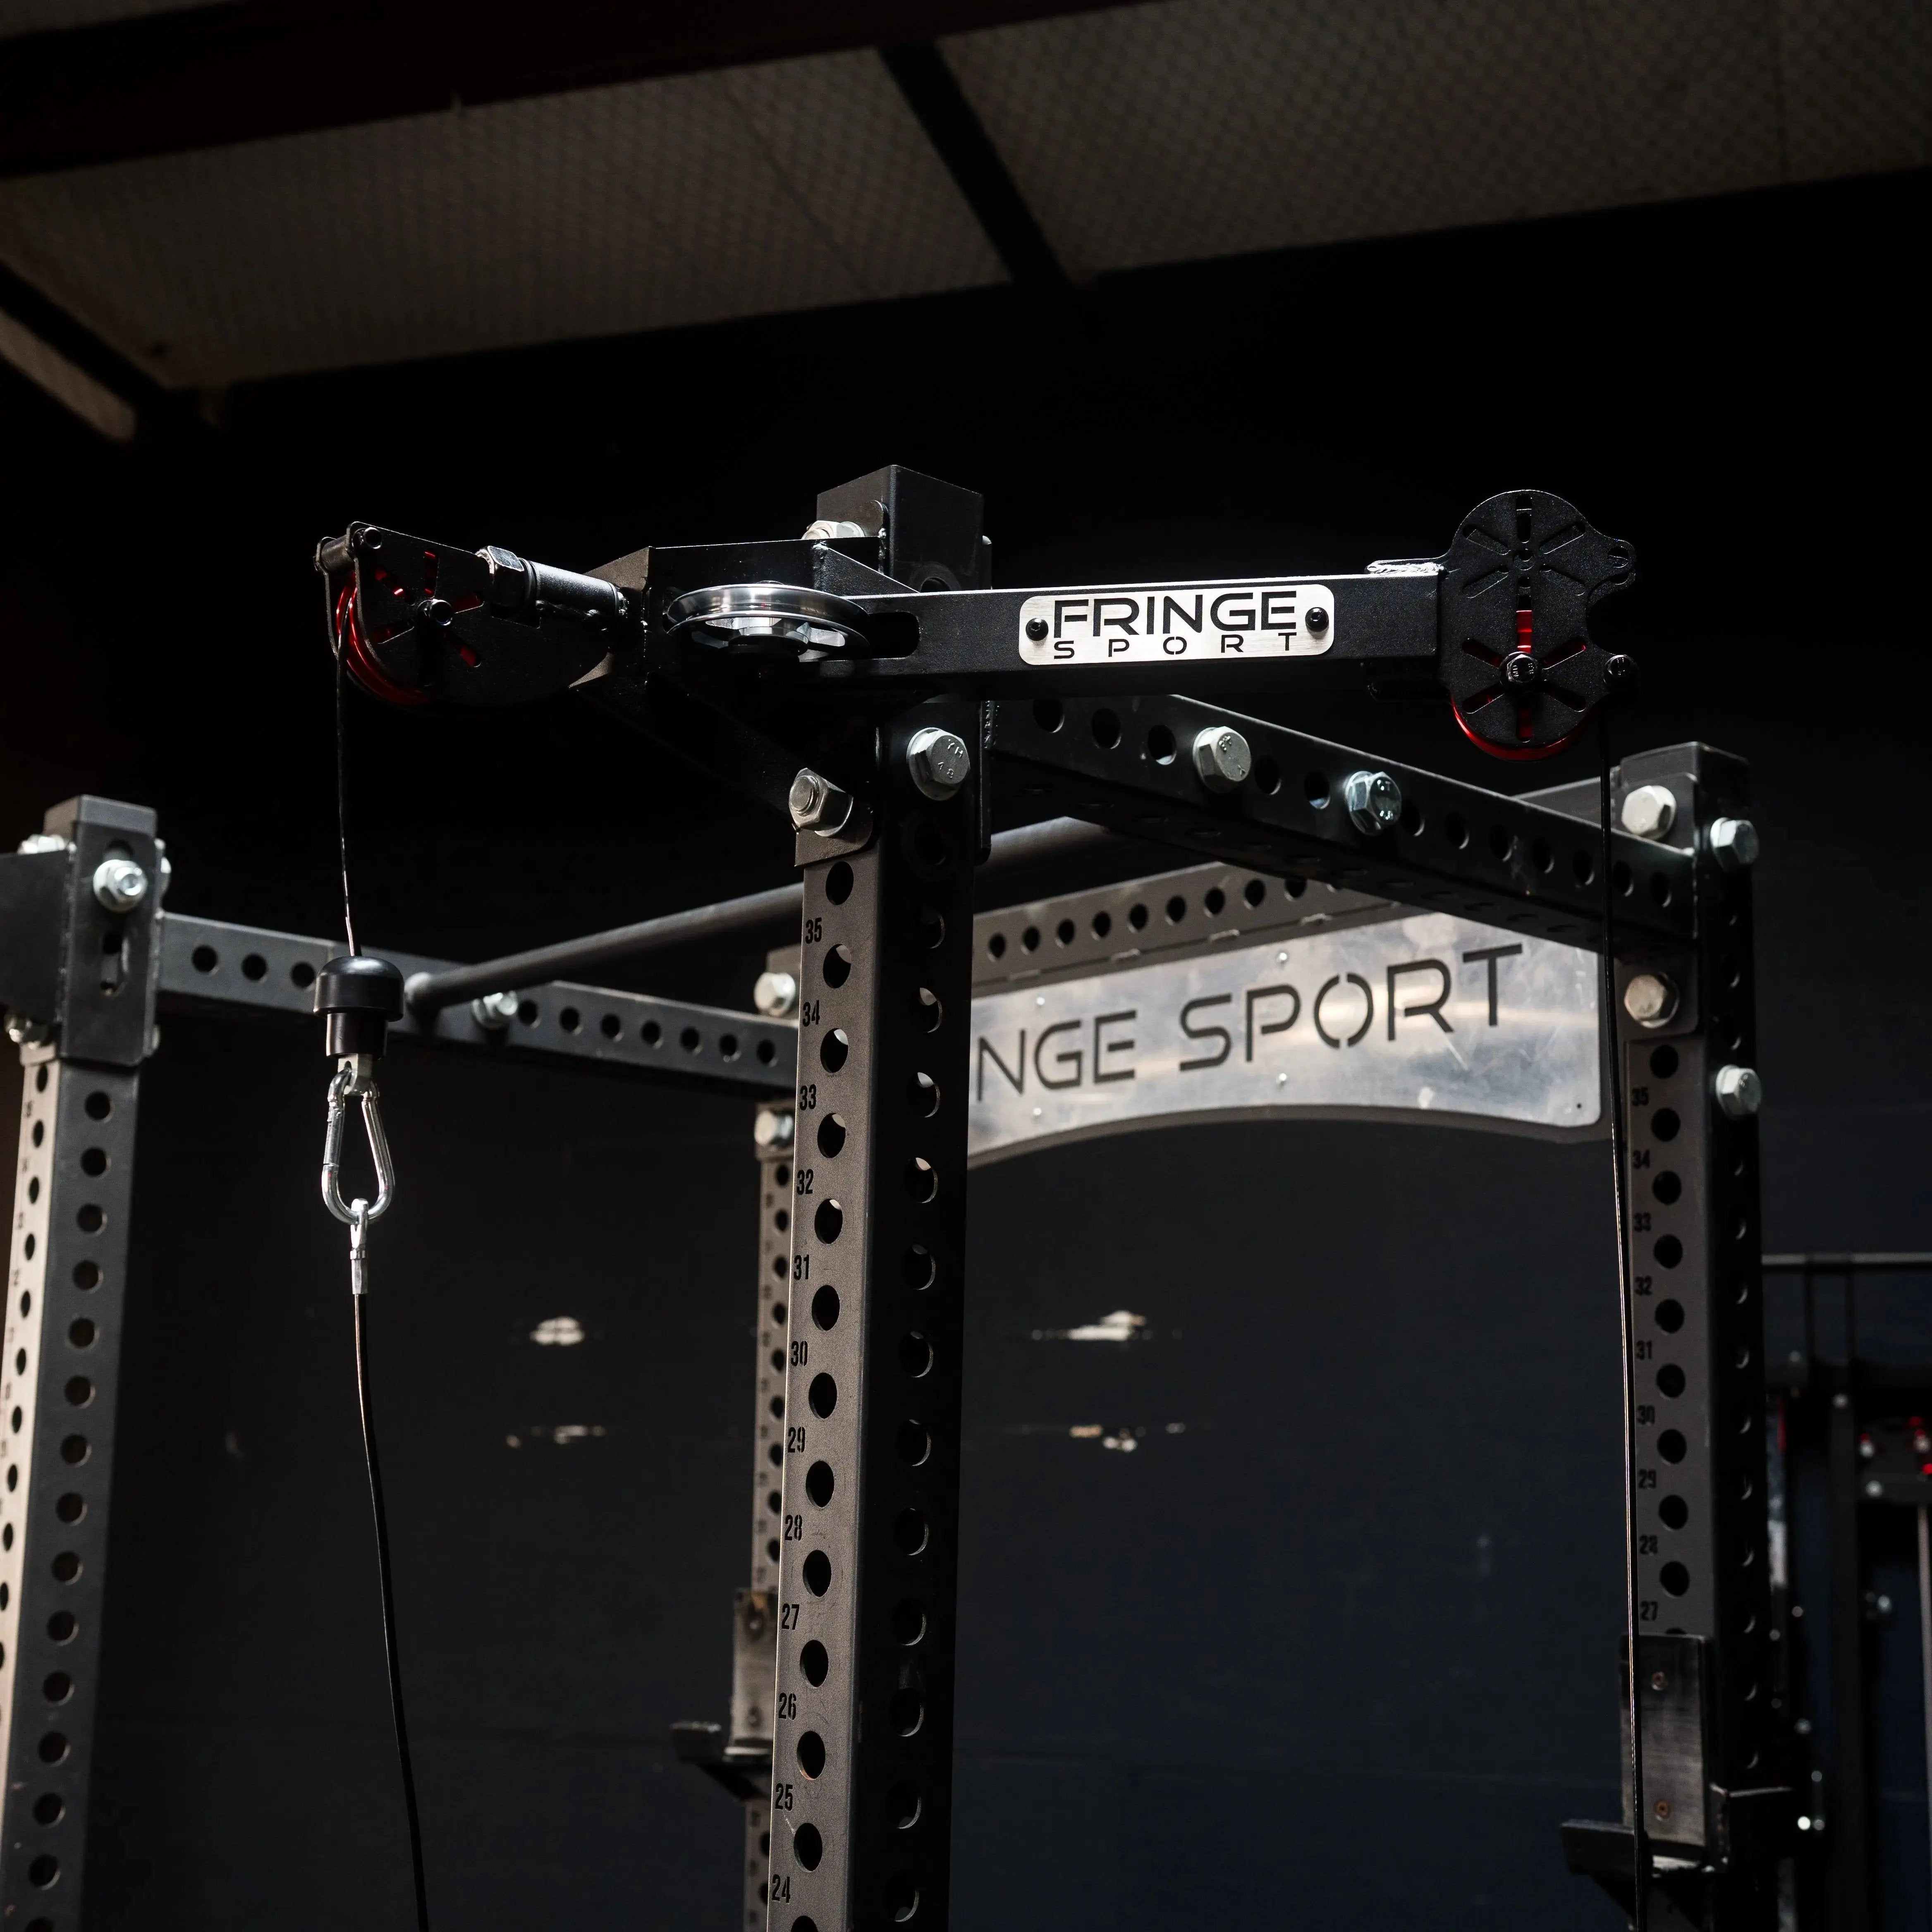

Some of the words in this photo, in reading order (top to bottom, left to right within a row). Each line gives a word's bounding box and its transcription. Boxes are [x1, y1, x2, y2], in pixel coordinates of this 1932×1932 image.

[1054, 591, 1297, 638] FRINGE
[1054, 632, 1297, 660] SPORT
[805, 917, 822, 944] 35
[802, 999, 820, 1027] 34
[1179, 943, 1523, 1071] SPORT
[799, 1083, 817, 1111] 33
[1631, 1086, 1650, 1107] 35
[1633, 1149, 1650, 1170] 34
[796, 1169, 814, 1196] 32
[1633, 1211, 1652, 1233] 33
[793, 1254, 810, 1281] 31
[1634, 1275, 1652, 1296] 32
[790, 1340, 808, 1367] 30
[1636, 1340, 1652, 1361] 31
[787, 1427, 806, 1453] 29
[1638, 1469, 1657, 1490] 29
[784, 1514, 803, 1541] 28
[781, 1602, 800, 1630] 27
[1640, 1600, 1659, 1621] 27
[778, 1692, 796, 1720] 26
[775, 1783, 793, 1811] 25
[771, 1874, 791, 1903] 24
